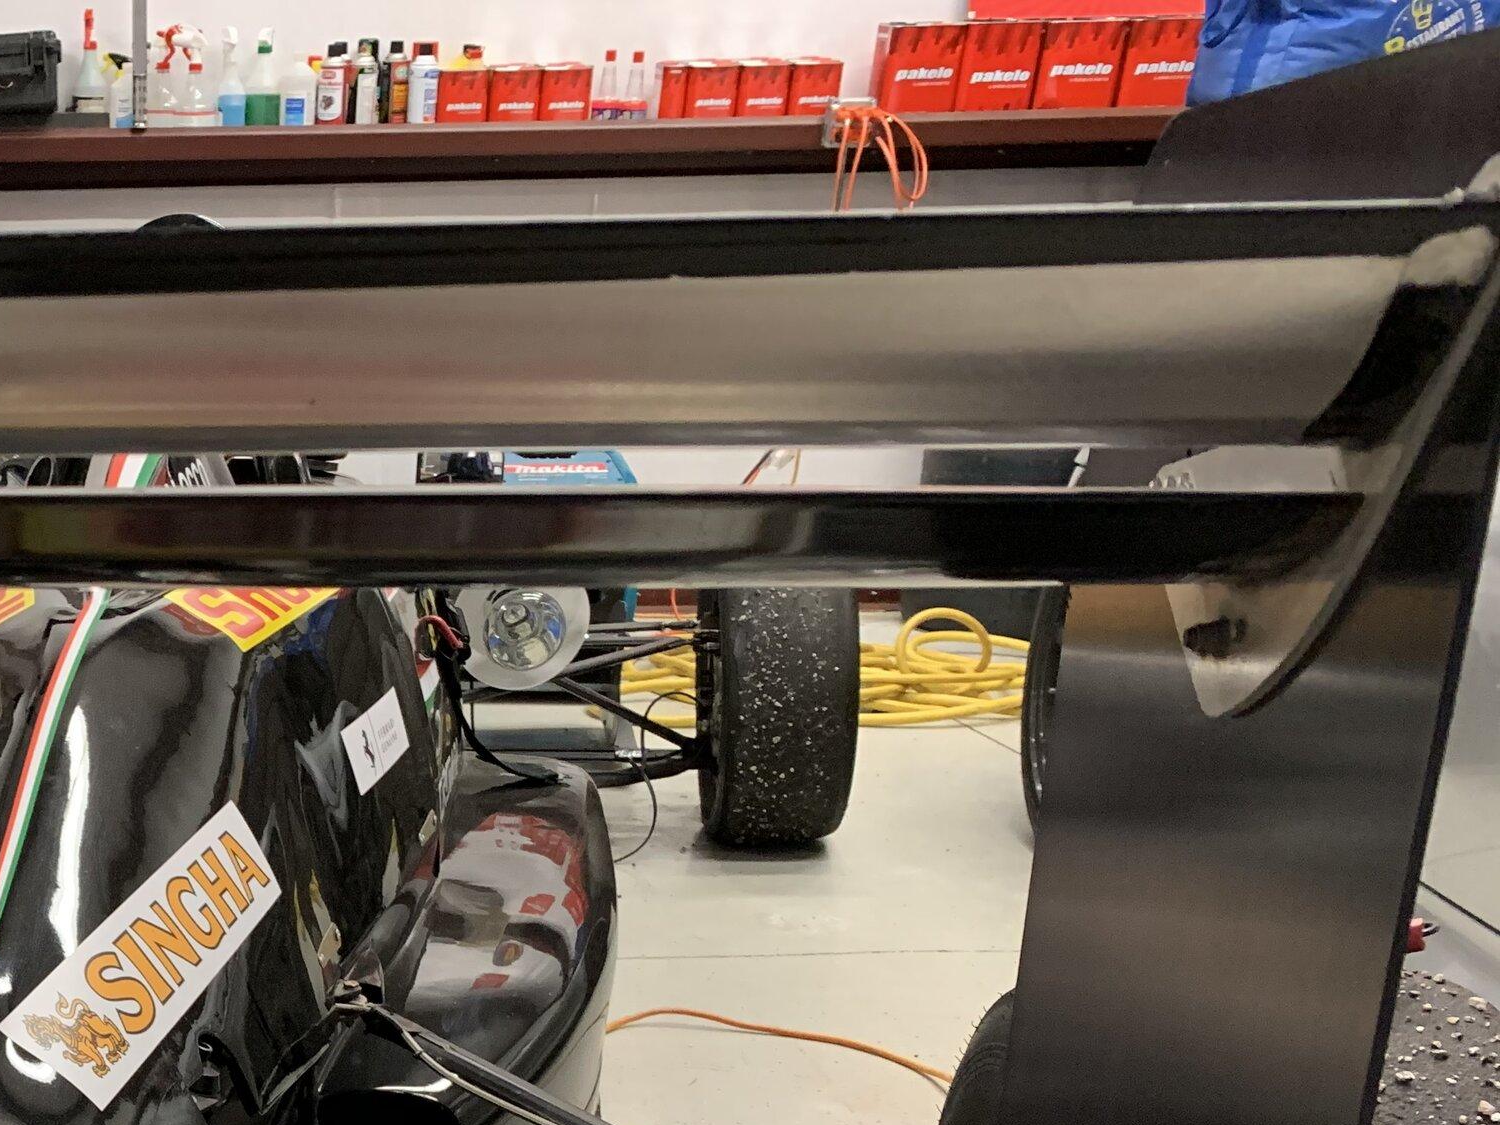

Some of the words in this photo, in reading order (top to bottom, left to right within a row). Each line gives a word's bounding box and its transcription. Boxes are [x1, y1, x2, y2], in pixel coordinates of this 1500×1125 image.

[894, 66, 954, 82] pakelo
[1050, 63, 1113, 77] pakelo
[1134, 60, 1195, 76] pakelo
[969, 69, 1031, 84] pakelo
[84, 830, 271, 1035] SINGHA
